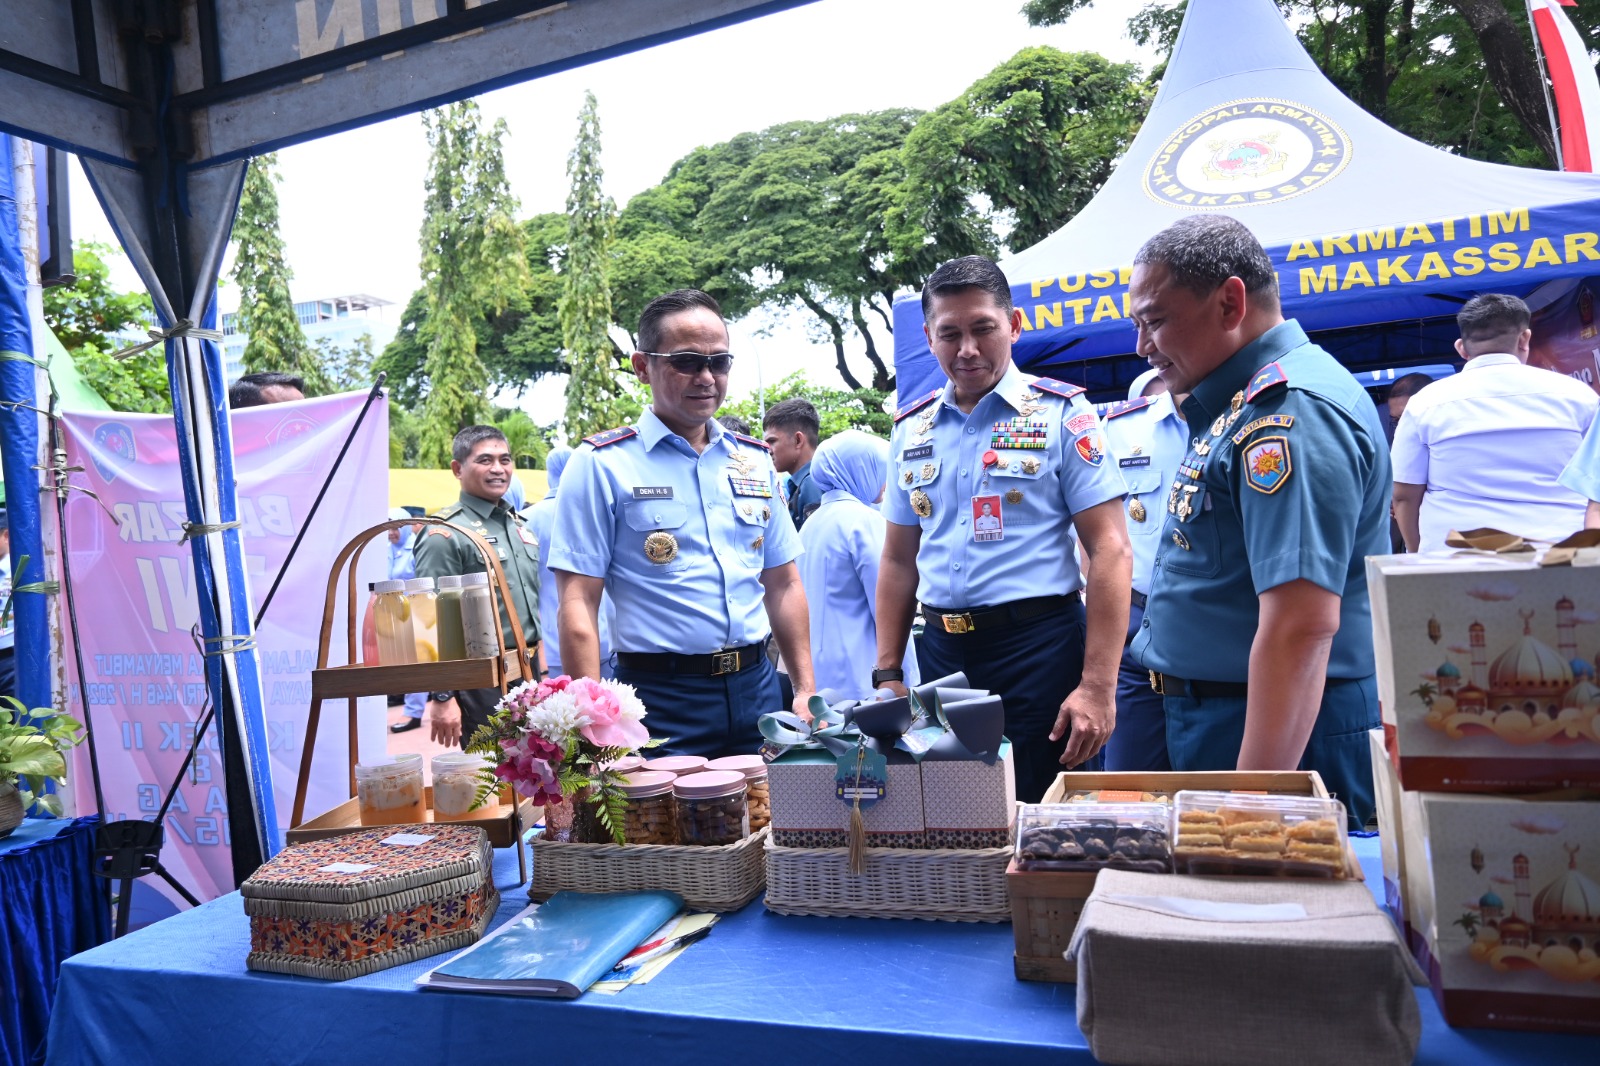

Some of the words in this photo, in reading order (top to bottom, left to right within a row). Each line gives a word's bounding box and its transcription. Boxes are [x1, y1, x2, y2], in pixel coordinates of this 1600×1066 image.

[1154, 105, 1246, 177] PUSKOPAL
[1250, 104, 1338, 146] ARMATIM
[1161, 162, 1335, 205] MAKASSAR
[1286, 207, 1531, 262] ARMATIM
[1299, 231, 1600, 295] MAKASSAR
